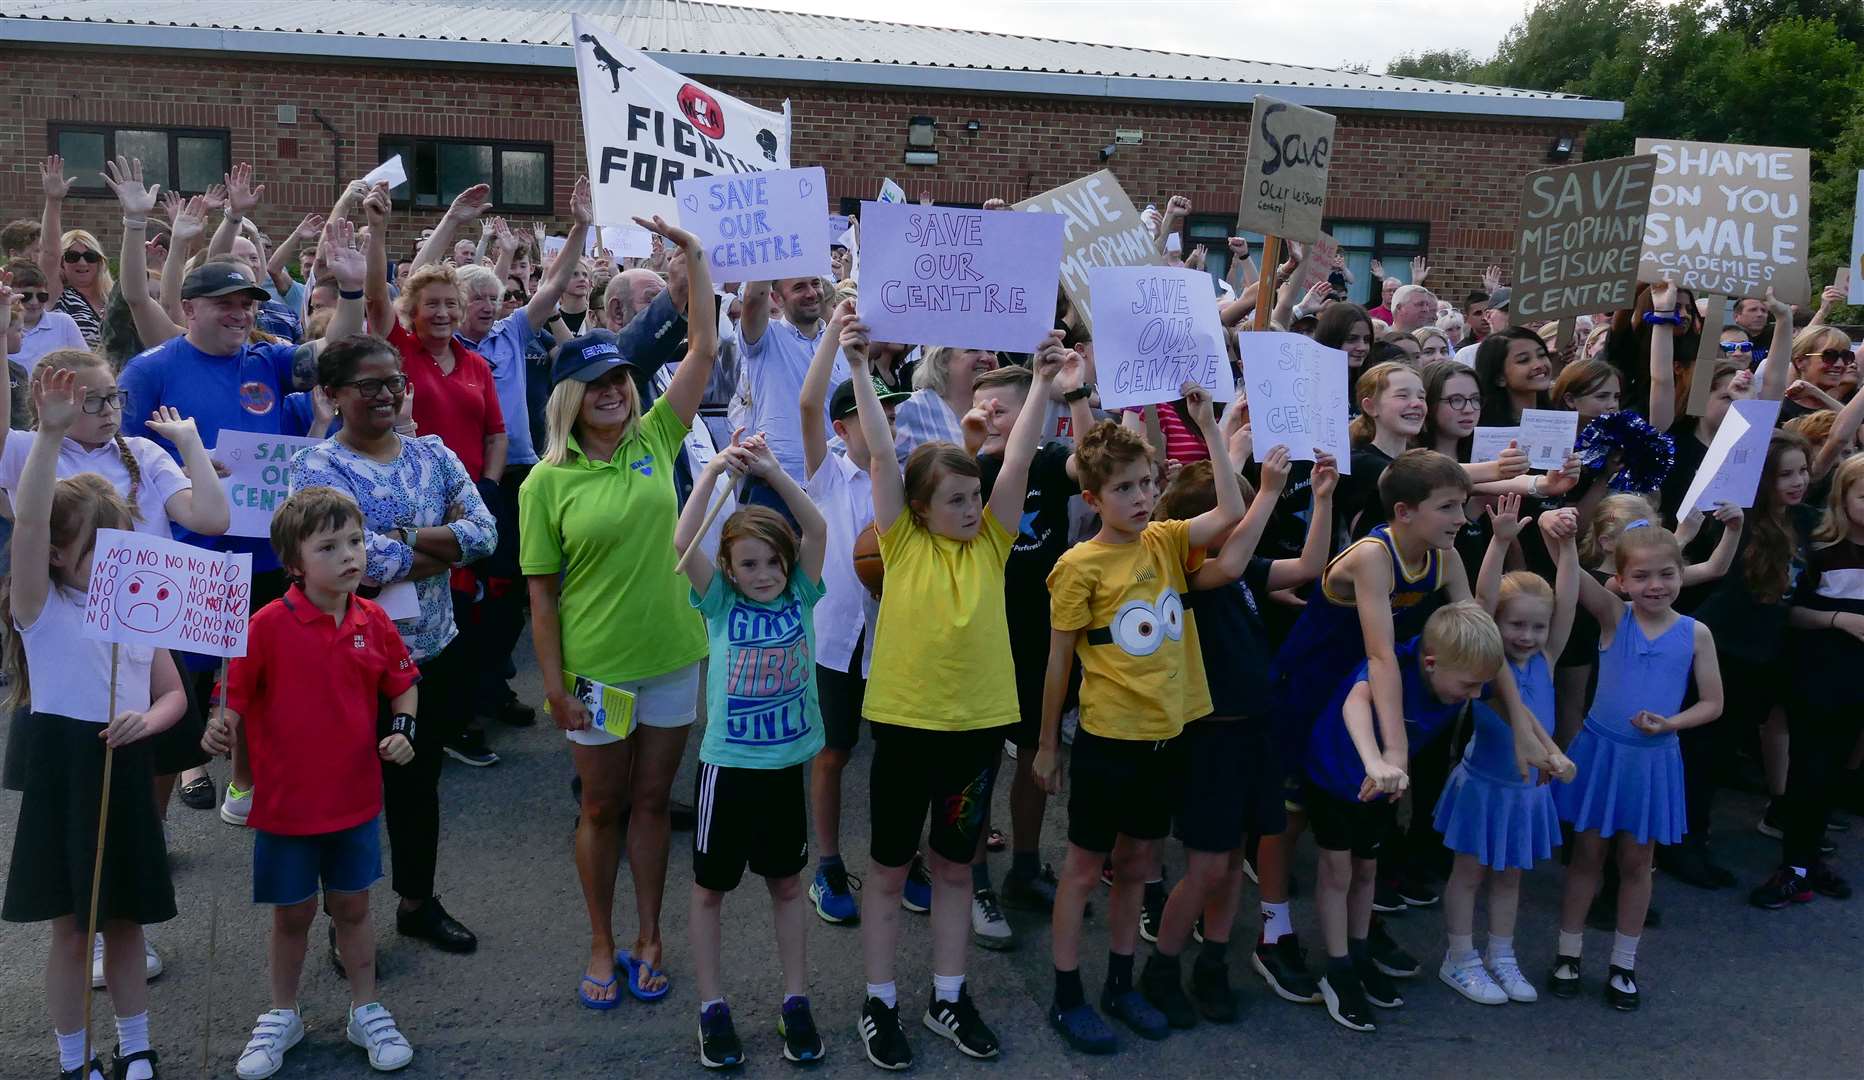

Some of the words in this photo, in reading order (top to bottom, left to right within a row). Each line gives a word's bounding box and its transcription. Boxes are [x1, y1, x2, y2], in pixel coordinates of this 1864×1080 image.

[1261, 103, 1328, 175] Save
[1650, 144, 1794, 181] SHAME
[708, 177, 769, 212] SAVE
[1527, 163, 1651, 219] SAVE
[1650, 184, 1700, 207] ON
[1718, 185, 1799, 219] YOU
[719, 209, 773, 240] OUR
[905, 213, 983, 248] SAVE
[1520, 214, 1648, 257] MEOPHAM
[1642, 213, 1799, 265] SWALE
[711, 233, 804, 268] CENTRE
[914, 252, 984, 281] OUR
[1519, 246, 1641, 285] LEISURE
[1640, 250, 1776, 281] ACADEMIES
[880, 280, 1028, 314] CENTRE
[1131, 277, 1190, 315] SAVE
[1518, 280, 1629, 316] CENTRE
[1657, 268, 1760, 295] TRUST
[1138, 316, 1198, 355] OUR
[1113, 354, 1219, 394] CENTRE
[95, 561, 118, 578] NO
[107, 548, 131, 565] NO
[136, 550, 158, 566] NO
[165, 554, 183, 569] NO
[188, 557, 205, 575] NO
[209, 560, 240, 582] NO
[88, 594, 110, 613] NO
[91, 578, 114, 596] NO
[186, 591, 203, 606] NO
[223, 598, 248, 617] NO
[189, 575, 207, 594] NO
[208, 580, 226, 596] NO
[226, 582, 249, 599] NO
[86, 610, 109, 631] NO
[179, 624, 201, 642] NO
[202, 631, 219, 645] NO
[220, 635, 237, 649] NO
[184, 608, 202, 627] NO
[203, 616, 222, 631] NO
[224, 619, 245, 633] NO
